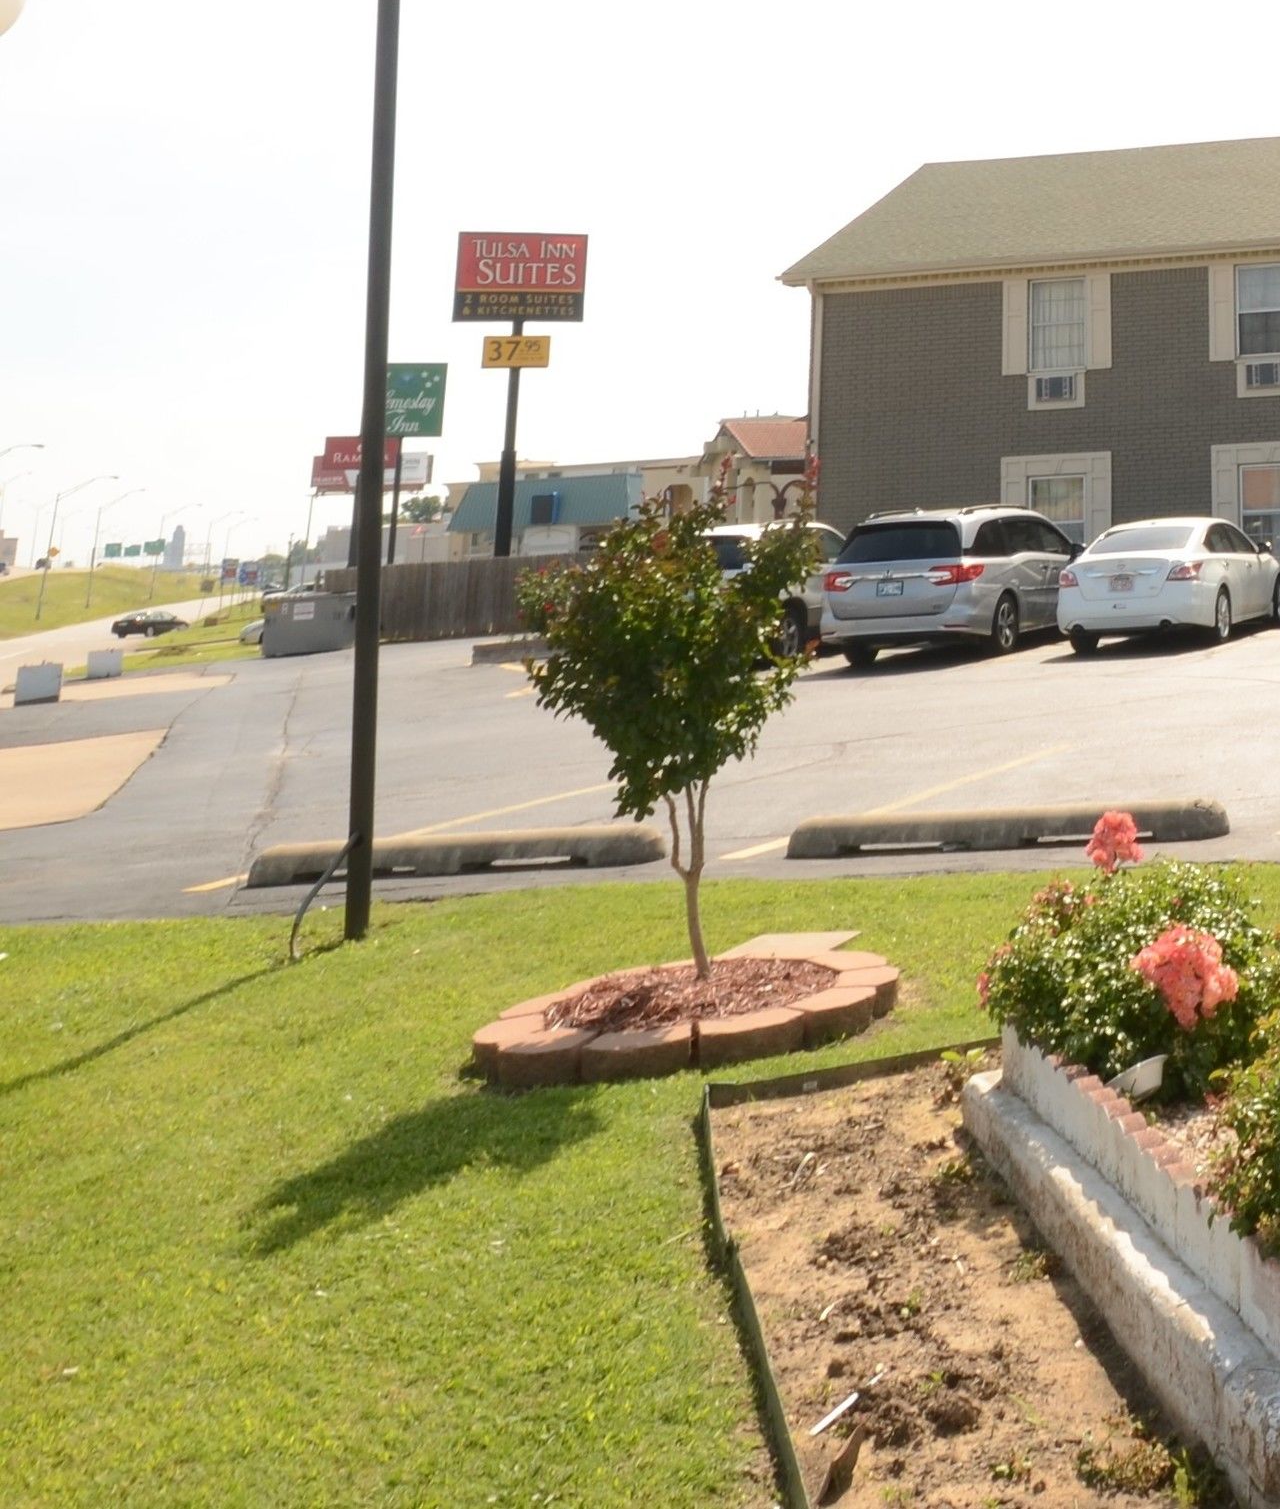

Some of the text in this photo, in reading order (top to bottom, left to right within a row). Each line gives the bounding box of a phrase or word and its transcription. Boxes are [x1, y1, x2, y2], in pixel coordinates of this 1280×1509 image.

[476, 259, 576, 285] SUITES
[464, 294, 575, 304] 2 ROOM SUITES
[477, 306, 575, 315] KITCHENETTES
[387, 414, 420, 433] Inn
